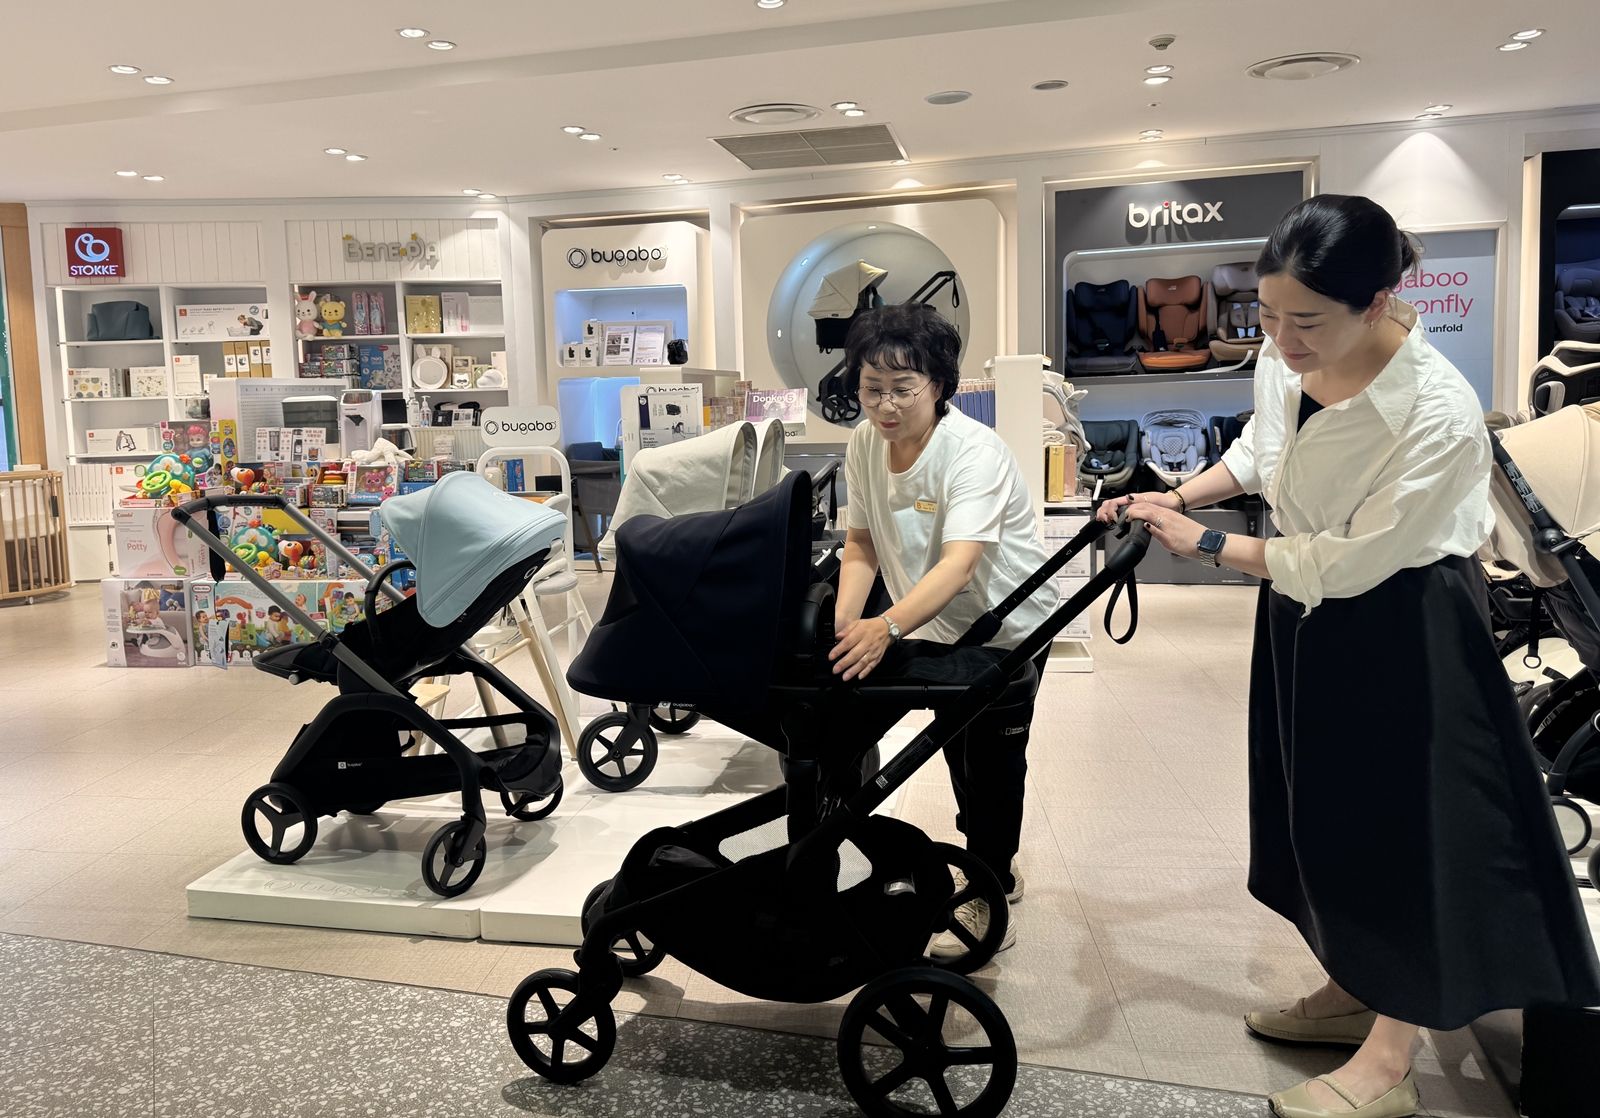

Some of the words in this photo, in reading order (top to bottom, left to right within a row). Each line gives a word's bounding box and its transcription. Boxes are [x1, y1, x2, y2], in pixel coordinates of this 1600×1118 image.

[1128, 200, 1224, 228] britax
[70, 265, 117, 276] STOKKE
[1409, 293, 1474, 318] onfly
[1428, 323, 1463, 333] unfold
[501, 420, 557, 435] bugaboo
[127, 542, 148, 552] Potty
